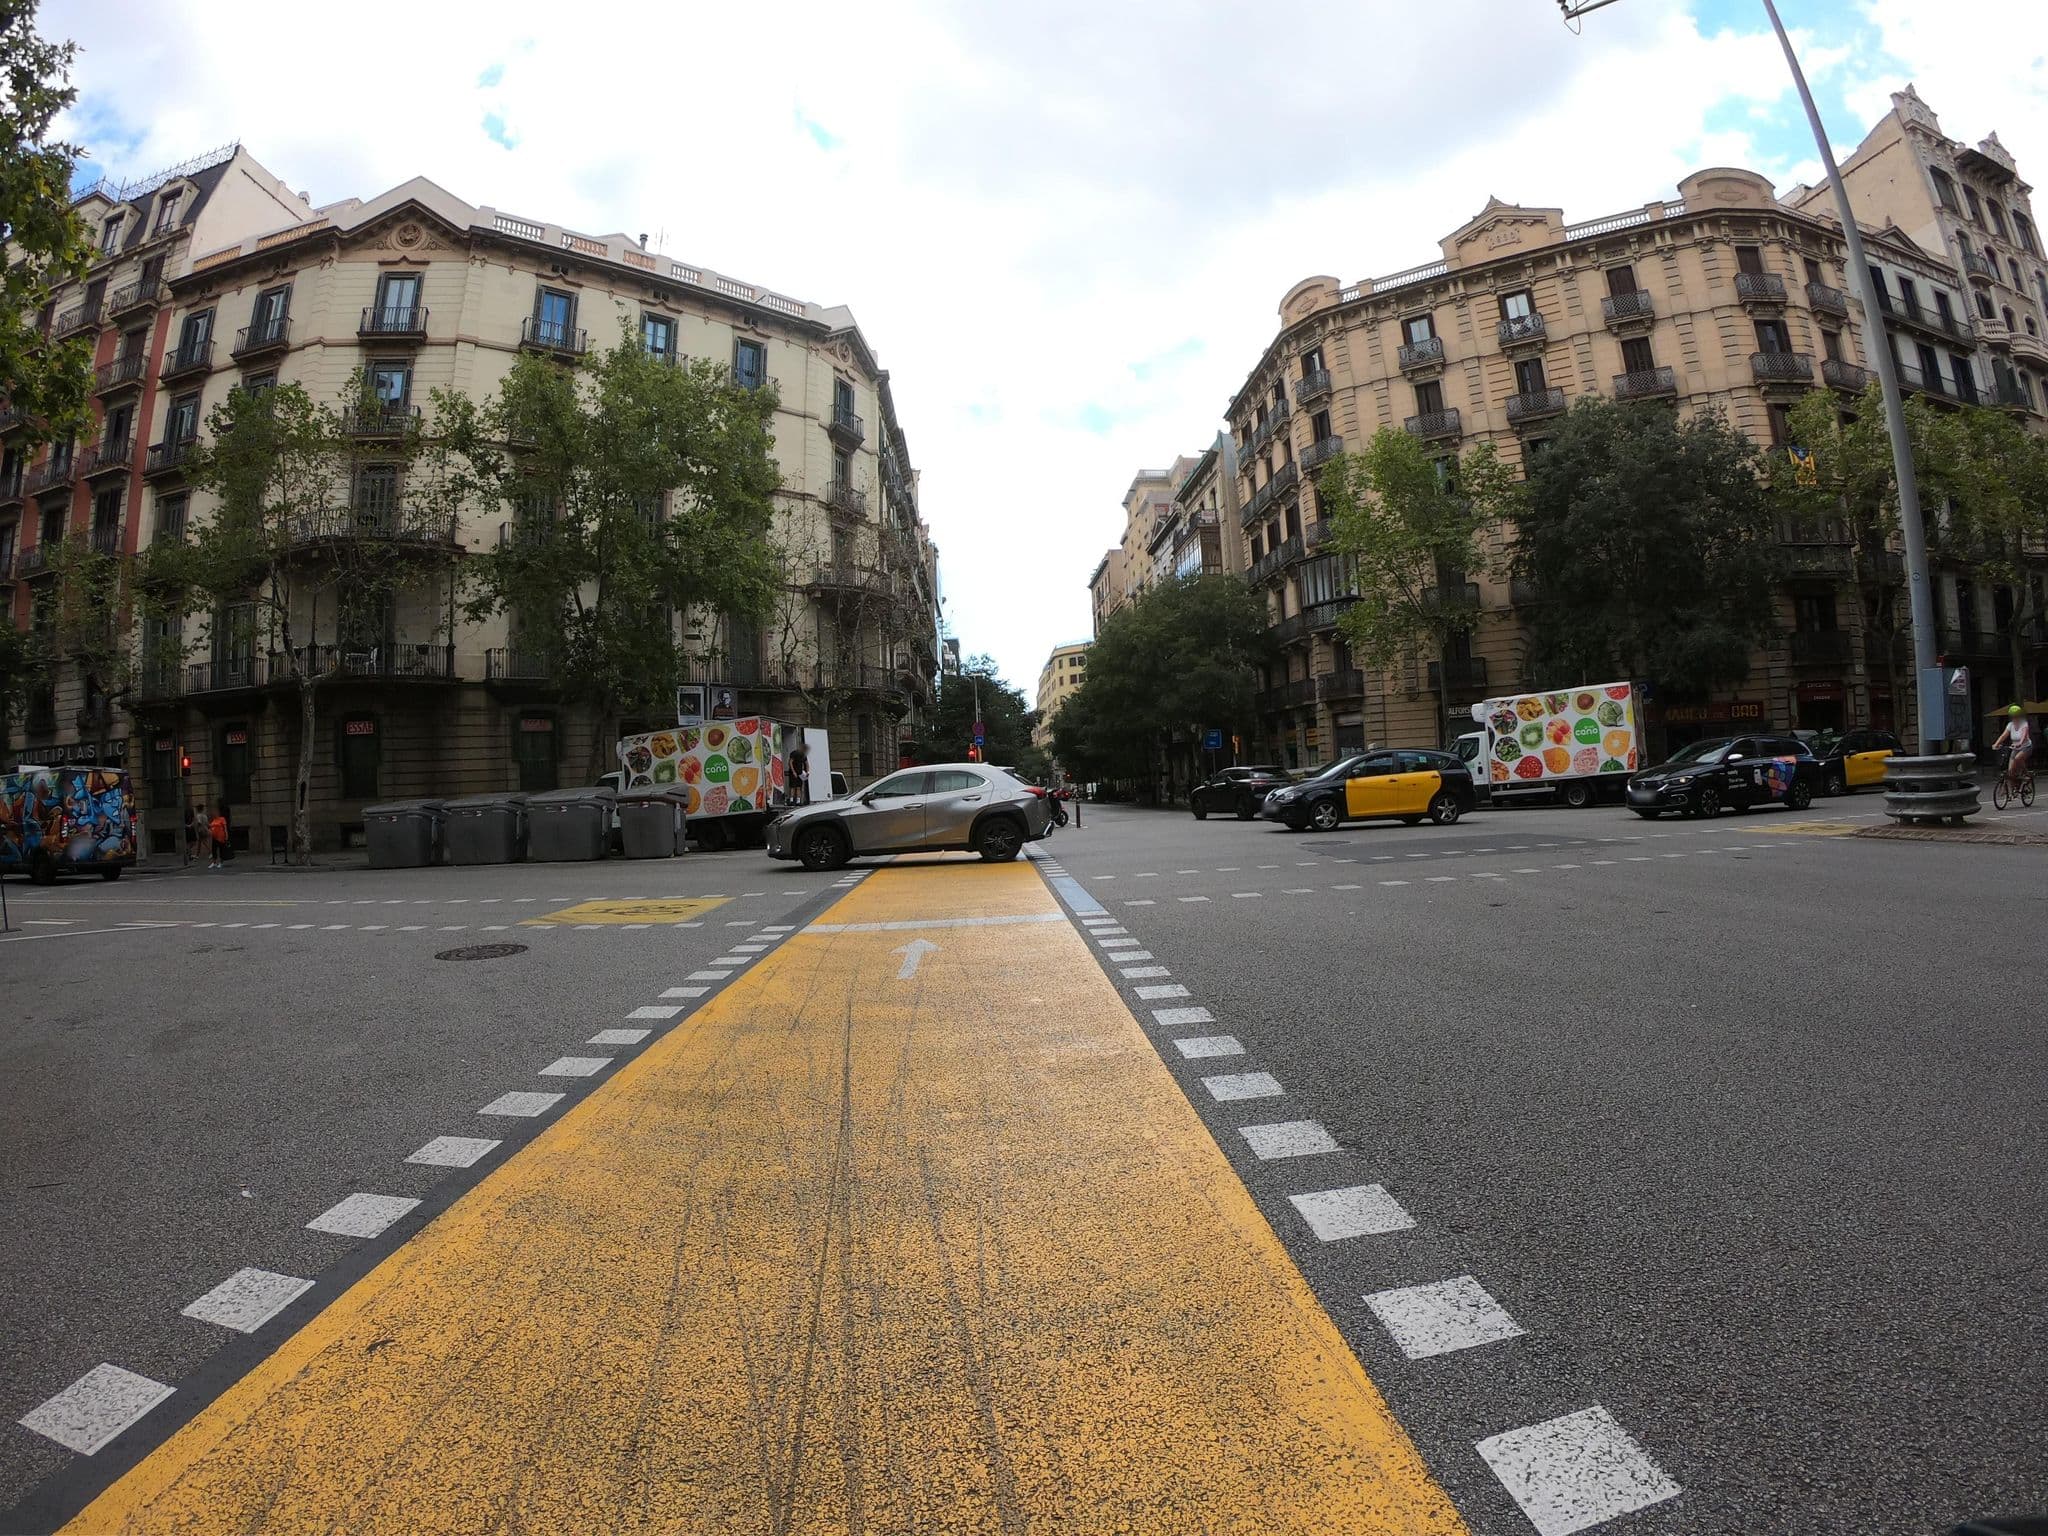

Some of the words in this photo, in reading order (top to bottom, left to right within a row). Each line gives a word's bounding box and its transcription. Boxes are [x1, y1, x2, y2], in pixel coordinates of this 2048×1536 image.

[1448, 706, 1472, 715] ALFONS
[1575, 728, 1598, 736] cano
[16, 741, 124, 764] MULTIPLASIC
[705, 765, 727, 775] cano
